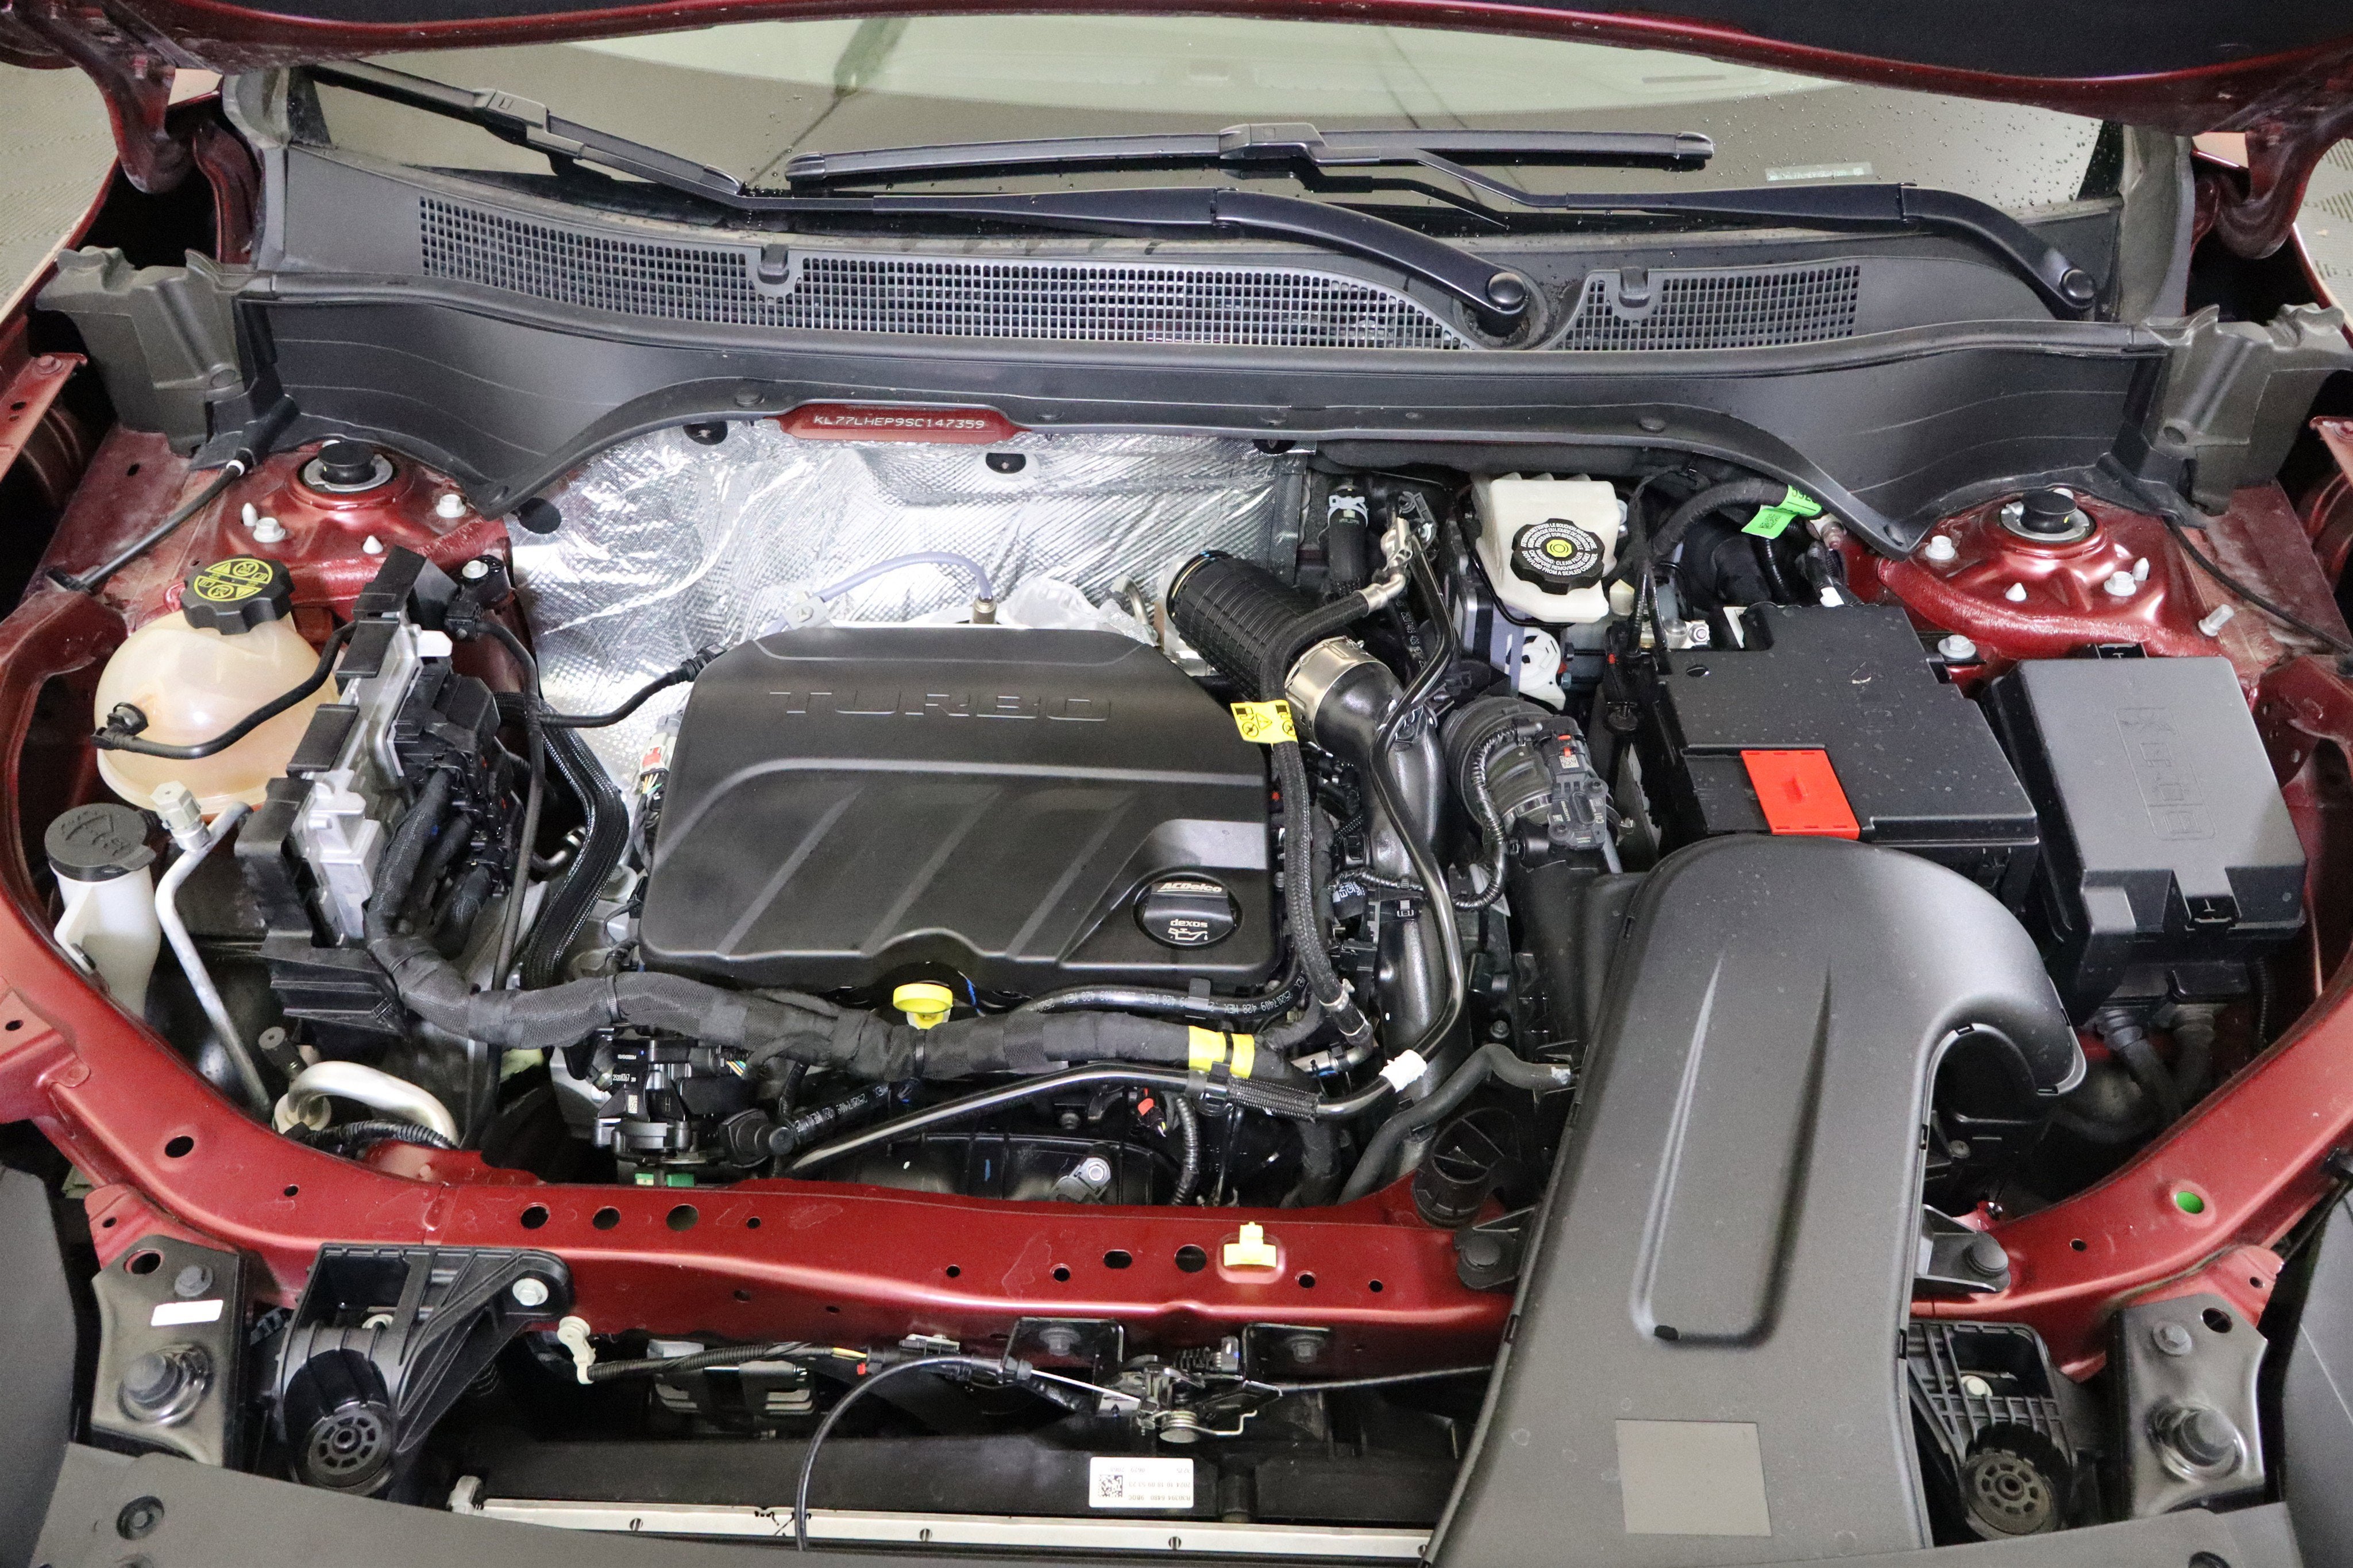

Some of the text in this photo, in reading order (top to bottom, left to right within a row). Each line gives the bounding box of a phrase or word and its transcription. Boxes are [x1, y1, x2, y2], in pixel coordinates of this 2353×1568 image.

[813, 415, 985, 430] KL77LHEP9SC147359
[1529, 559, 1542, 569] FLUID
[1542, 567, 1557, 575] FROM
[1534, 557, 1552, 568] BEFORE
[770, 690, 1111, 723] TURBO
[1159, 883, 1222, 893] ACDelco
[1170, 919, 1208, 928] dexos
